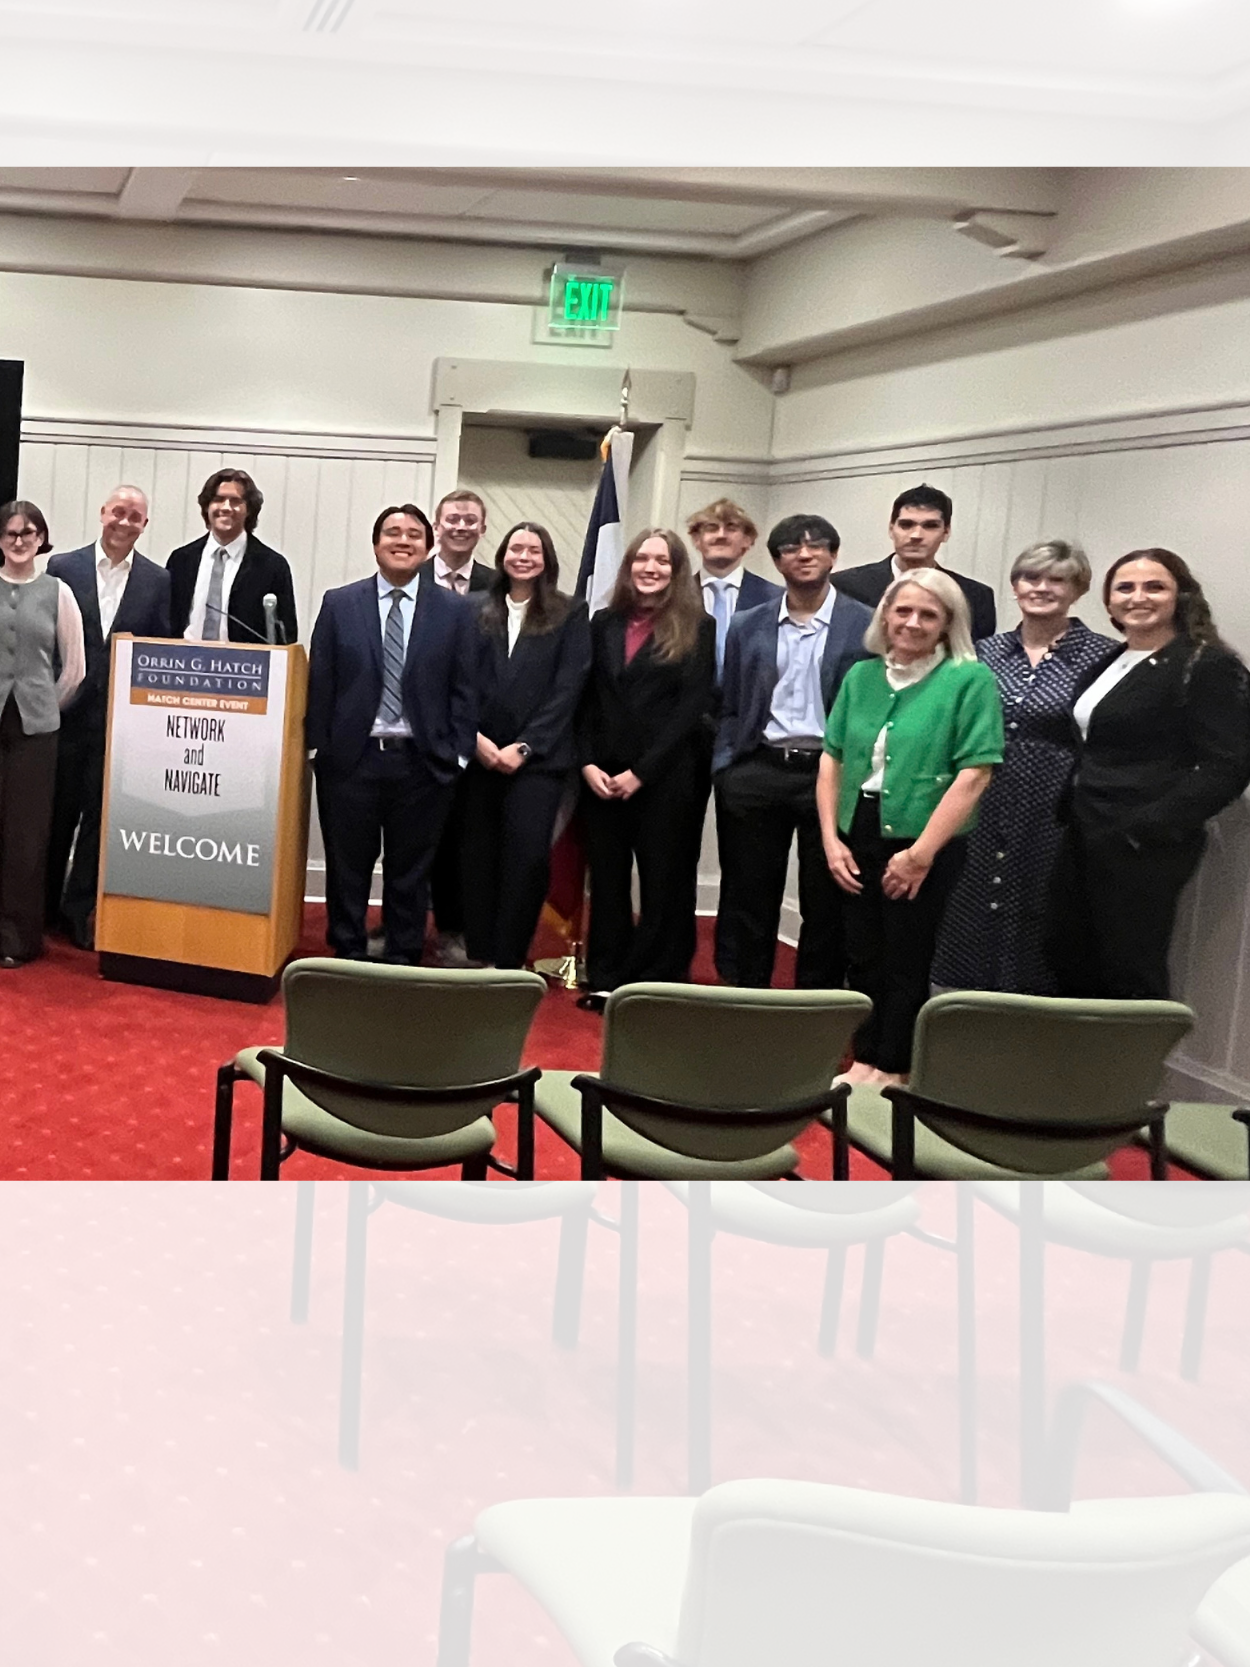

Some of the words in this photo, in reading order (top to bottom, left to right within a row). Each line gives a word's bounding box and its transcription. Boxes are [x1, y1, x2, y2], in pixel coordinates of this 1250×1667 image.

[564, 281, 613, 321] EXIT
[137, 654, 185, 670] ORRIN
[210, 659, 263, 675] HATCH
[137, 673, 262, 691] FOUNDATION
[147, 693, 181, 705] HATCH
[182, 697, 218, 708] CENTER
[219, 699, 249, 711] EVENT
[166, 715, 226, 742] NETWORK
[183, 743, 205, 766] and
[164, 769, 222, 797] NAVIGATE
[119, 828, 260, 867] WELCOME
